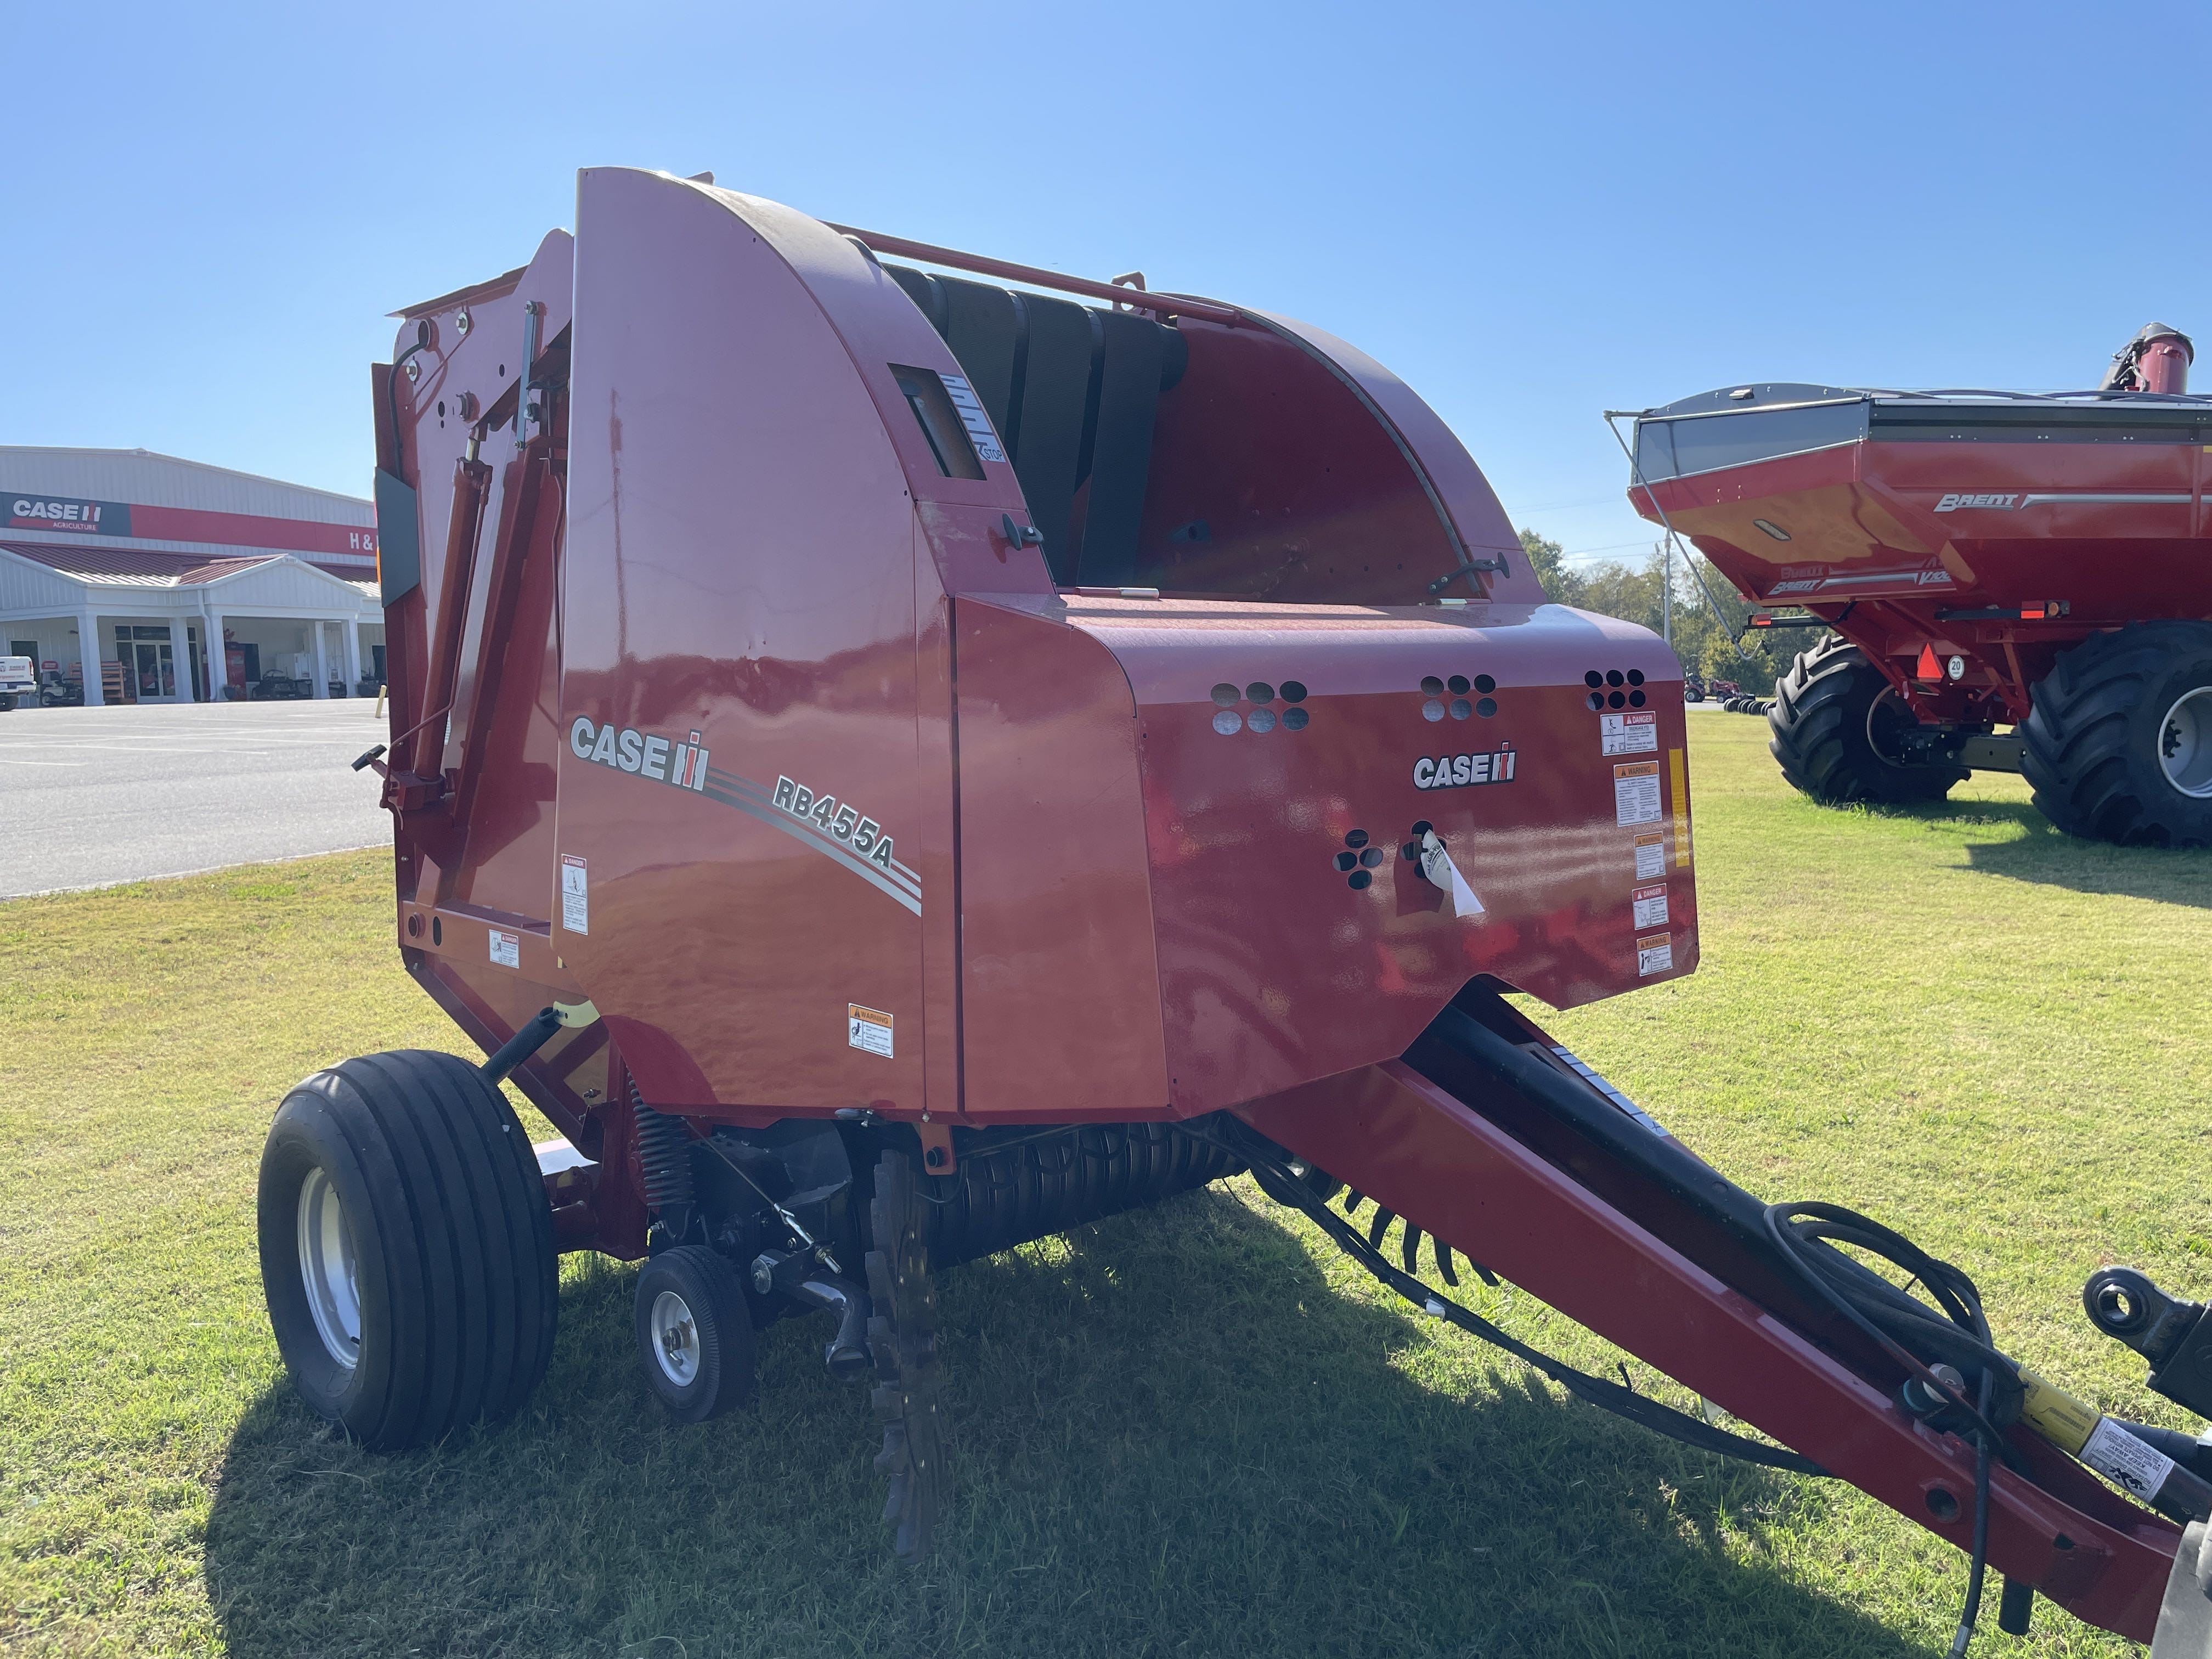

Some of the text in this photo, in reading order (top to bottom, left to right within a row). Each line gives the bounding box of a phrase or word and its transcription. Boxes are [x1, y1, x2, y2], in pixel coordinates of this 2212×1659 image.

[984, 448, 1002, 460] STOP
[13, 500, 79, 520] CASE
[1933, 494, 2019, 512] BRENT
[53, 522, 97, 531] AGRICULTURE
[349, 532, 359, 550] H
[363, 534, 373, 551] &
[1768, 579, 1821, 595] BRENT
[1951, 661, 1961, 670] 20
[1632, 715, 1653, 724] DANGER
[571, 717, 669, 781] CASE
[1413, 754, 1490, 789] CASE
[1628, 766, 1651, 775] WARNING
[772, 774, 894, 871] RB455A
[568, 857, 584, 866] DANGER
[1644, 888, 1662, 898] DANGER
[1645, 936, 1667, 946] WARNING
[861, 1011, 888, 1024] WARNING
[2108, 1443, 2129, 1458] AWAY!
[2124, 1447, 2143, 1461] OPERATE
[2095, 1447, 2151, 1484] ROTATING DRIVE SHAFT
[2128, 1455, 2146, 1469] KEEP
[2143, 1459, 2153, 1467] NOT
